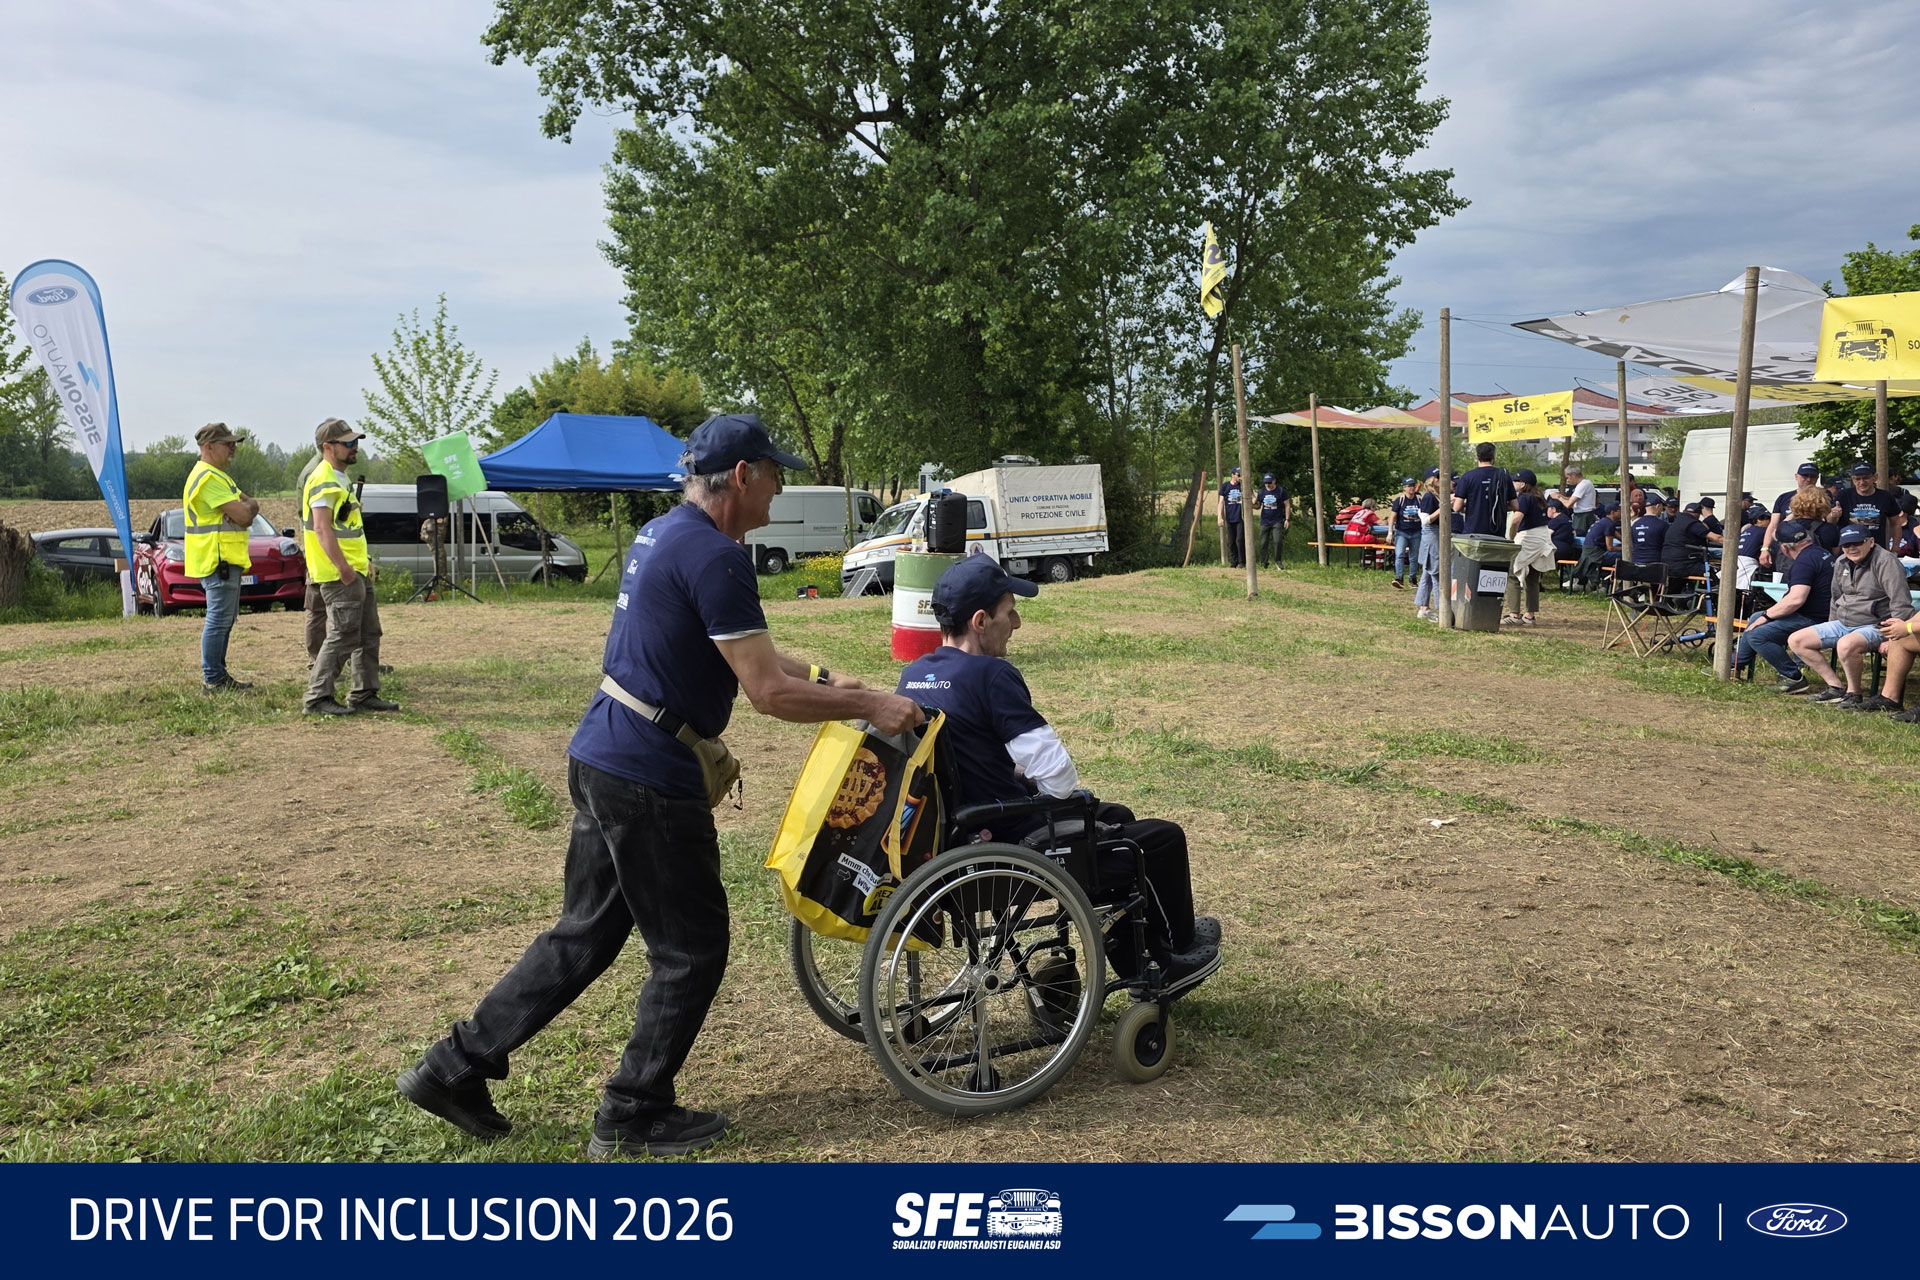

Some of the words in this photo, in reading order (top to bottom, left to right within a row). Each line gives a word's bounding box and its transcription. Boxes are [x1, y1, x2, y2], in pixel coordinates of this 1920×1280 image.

[1503, 400, 1530, 414] sfe
[1032, 494, 1068, 502] OPERATIVA
[1021, 511, 1062, 519] PROTEZIONE
[1065, 509, 1086, 517] CIVILE
[1479, 574, 1506, 588] CARTA
[905, 680, 951, 691] BISSONAUTO
[841, 856, 861, 871] Mmm
[869, 898, 883, 912] AL
